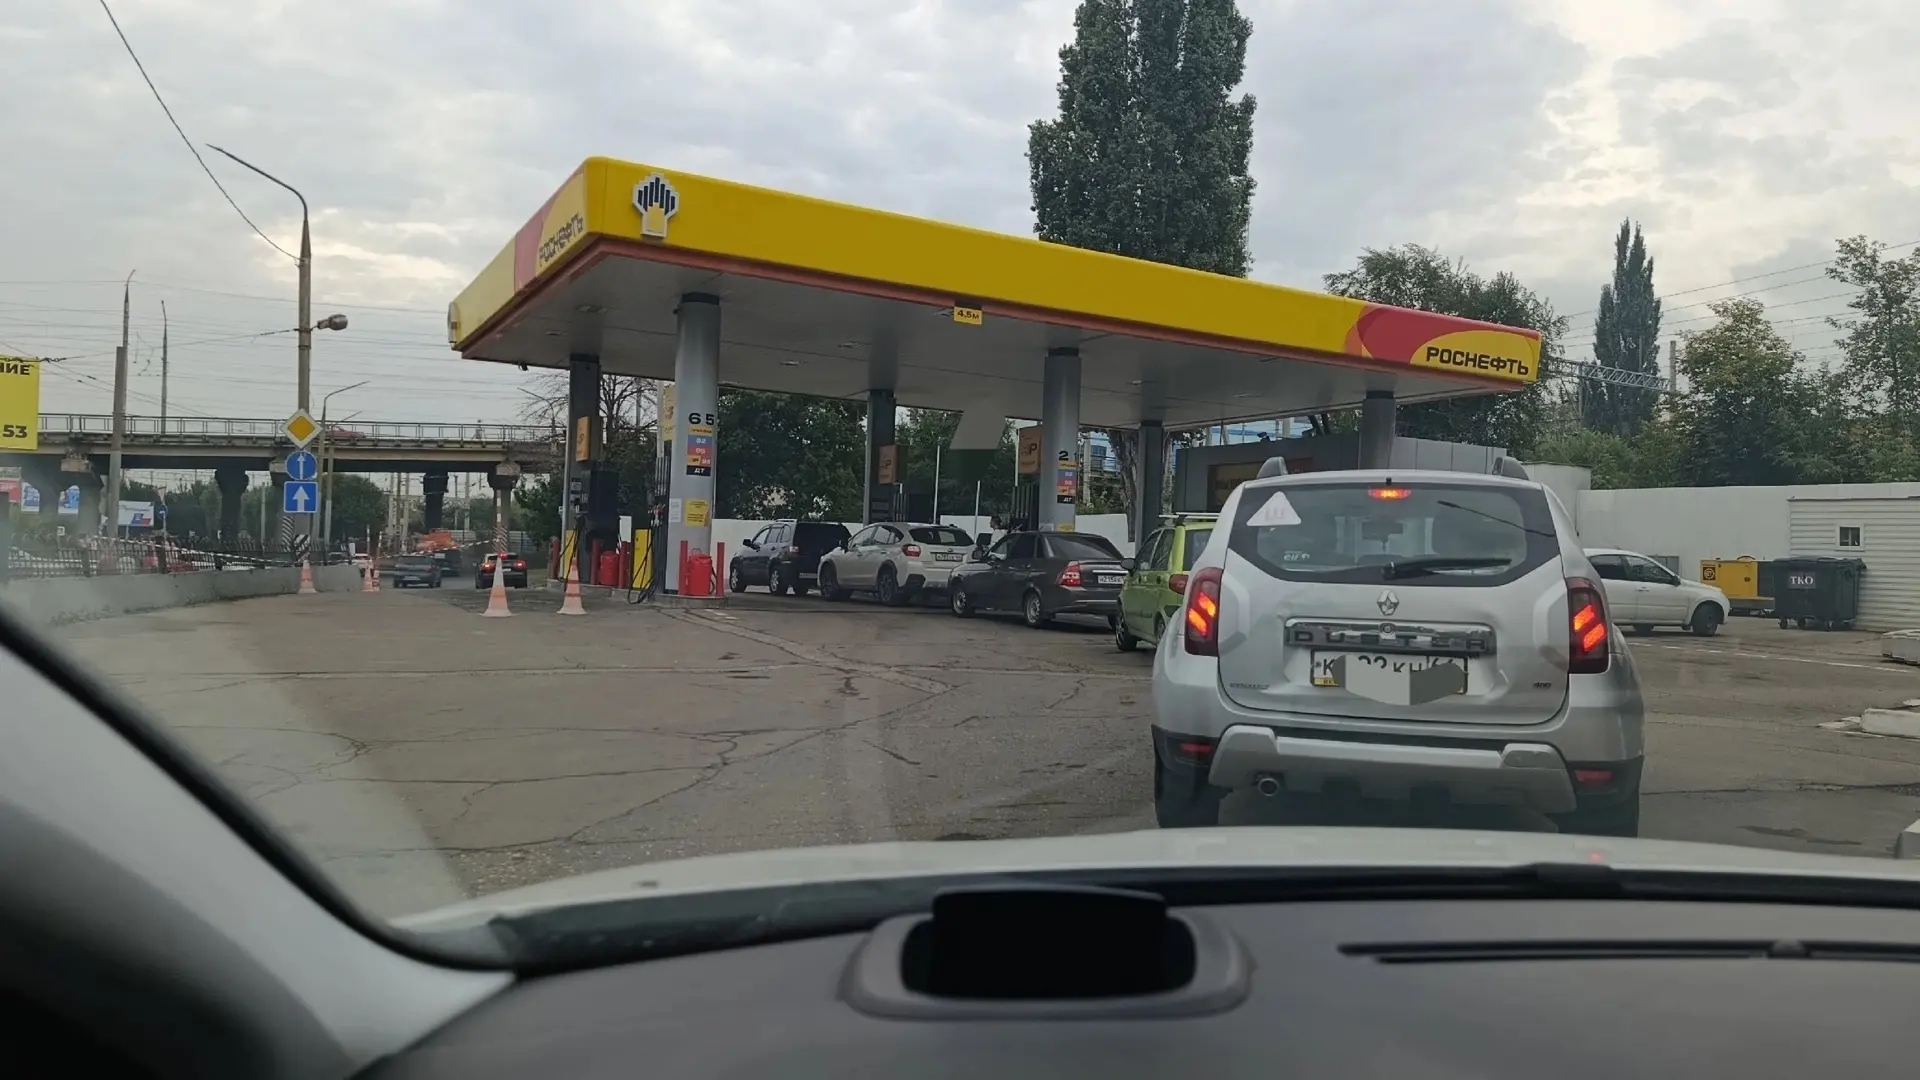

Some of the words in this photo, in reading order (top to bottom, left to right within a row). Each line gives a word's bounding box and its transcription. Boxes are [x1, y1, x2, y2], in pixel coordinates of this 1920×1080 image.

[1426, 346, 1529, 376] РОСНЕФТЬ
[688, 412, 702, 425] 6
[705, 413, 715, 426] 5
[1058, 450, 1069, 461] 2
[1790, 576, 1814, 585] ТКО
